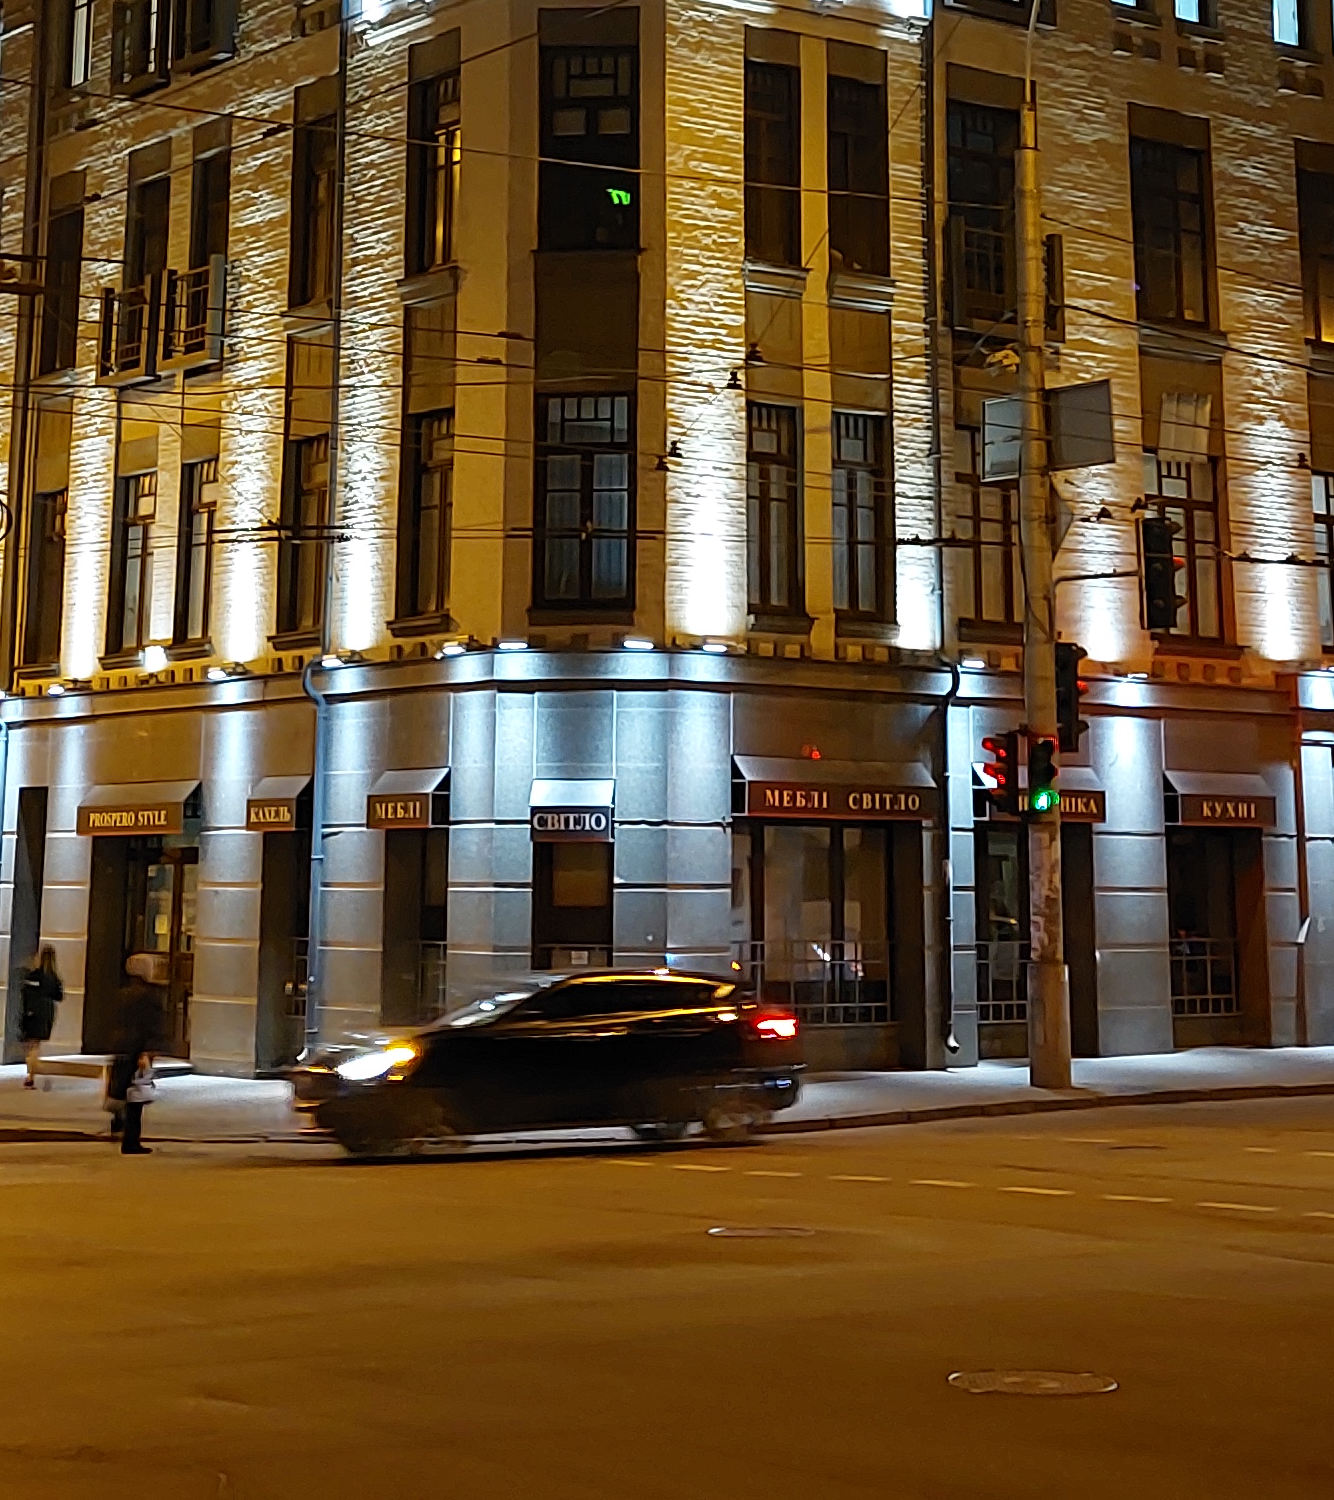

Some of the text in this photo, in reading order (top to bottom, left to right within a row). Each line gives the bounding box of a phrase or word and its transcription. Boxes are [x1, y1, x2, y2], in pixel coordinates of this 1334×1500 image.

[764, 789, 920, 811] МЕБЛІ СВІТЛО
[1202, 800, 1256, 819] КУХНІ
[89, 810, 167, 827] PROSPERO STYLE
[250, 806, 291, 823] КАХЕЛЬ
[375, 801, 421, 820] МЕБЛІ
[533, 812, 607, 831] СВІТЛО
